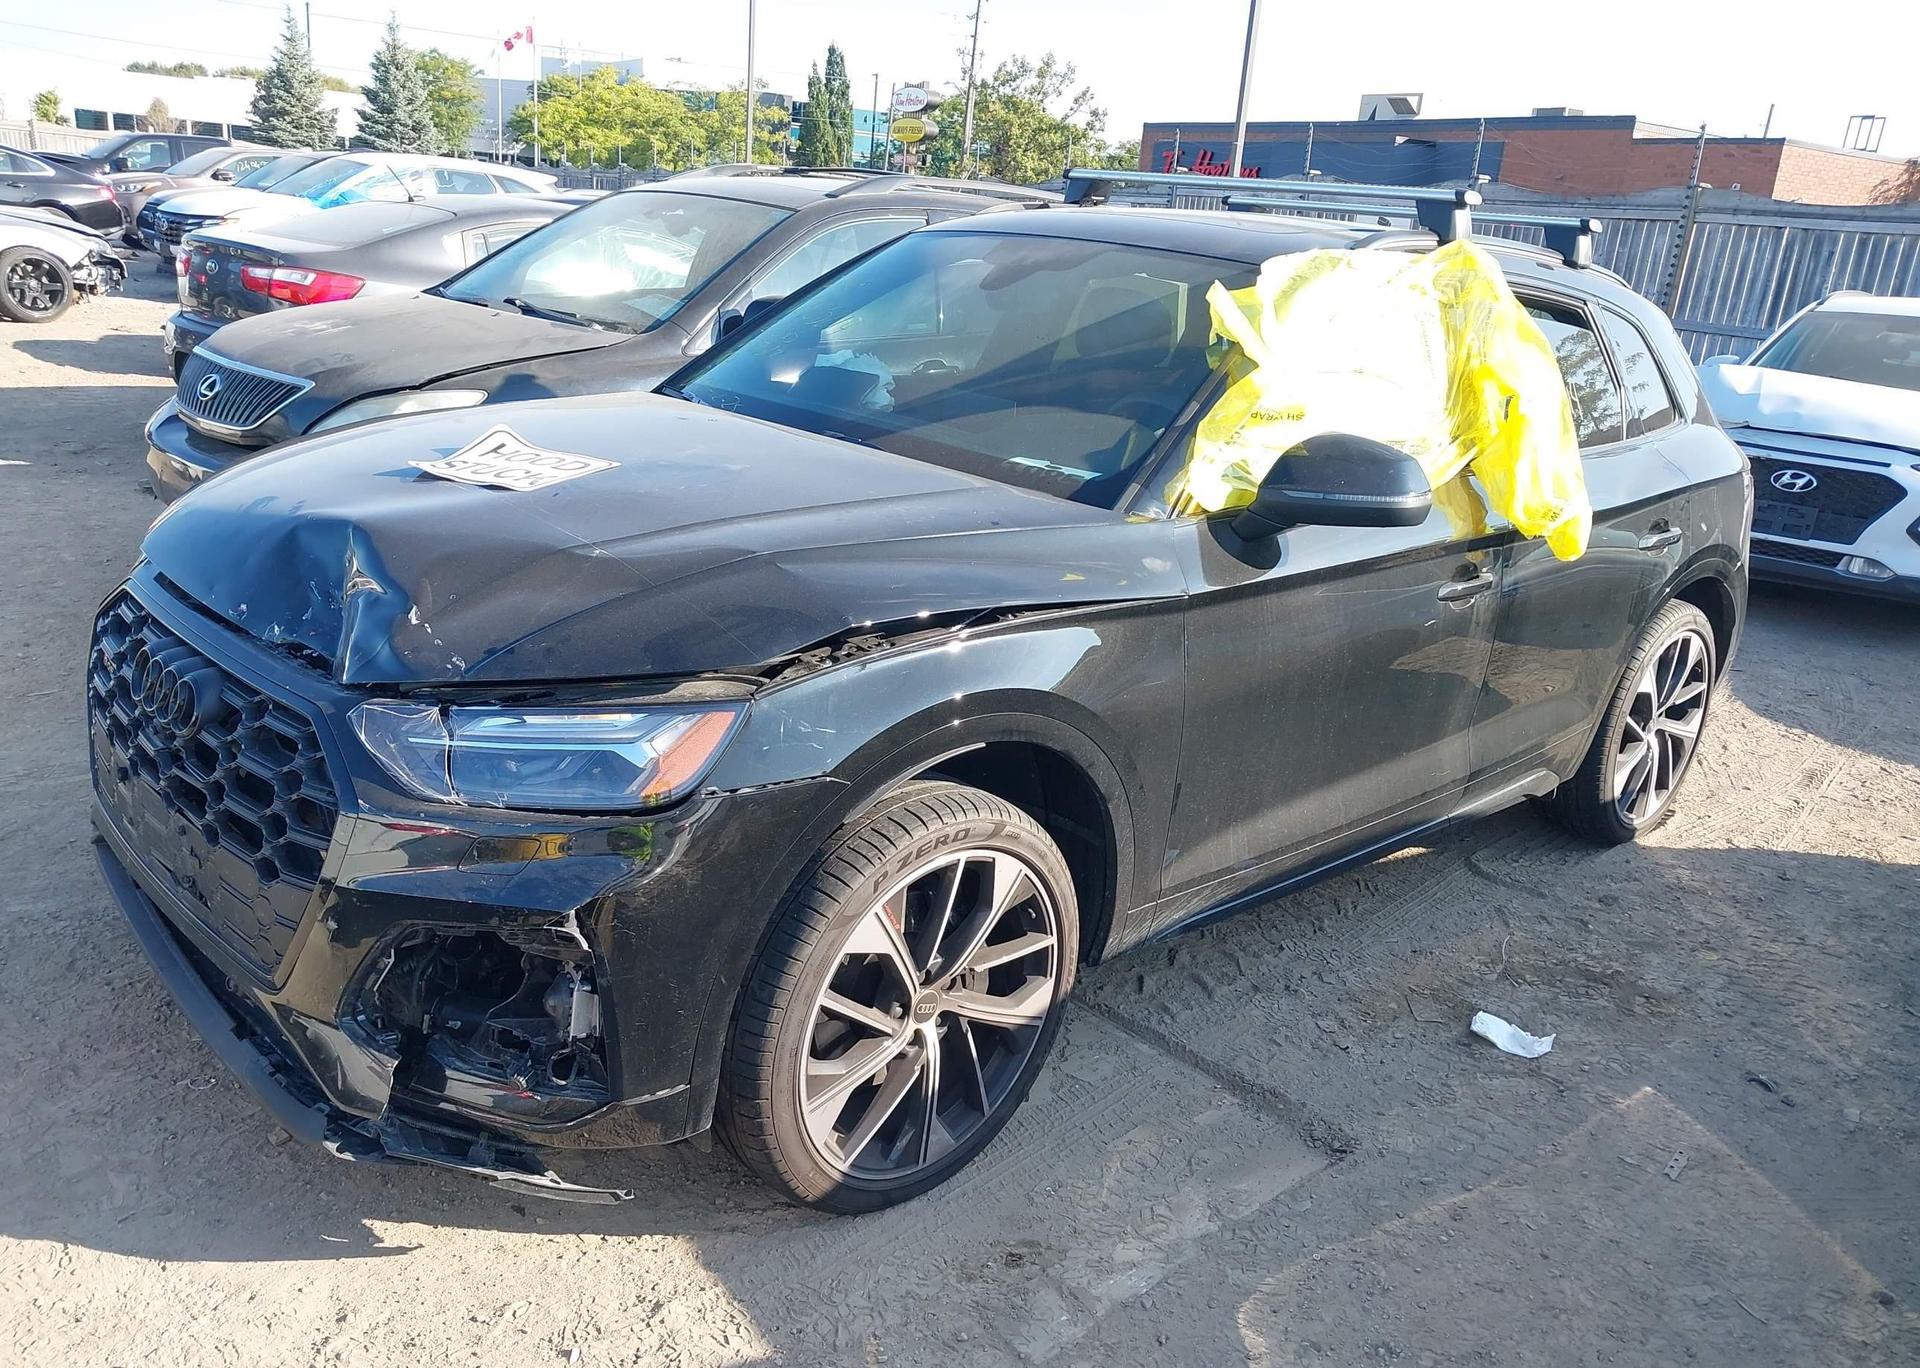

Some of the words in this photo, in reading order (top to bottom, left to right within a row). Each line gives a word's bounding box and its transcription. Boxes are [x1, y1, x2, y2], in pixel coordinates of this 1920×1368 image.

[1191, 148, 1261, 177] Hortns
[478, 442, 591, 472] HOOD
[430, 460, 553, 486] STUCK
[873, 870, 889, 894] P
[896, 827, 972, 874] ZERO
